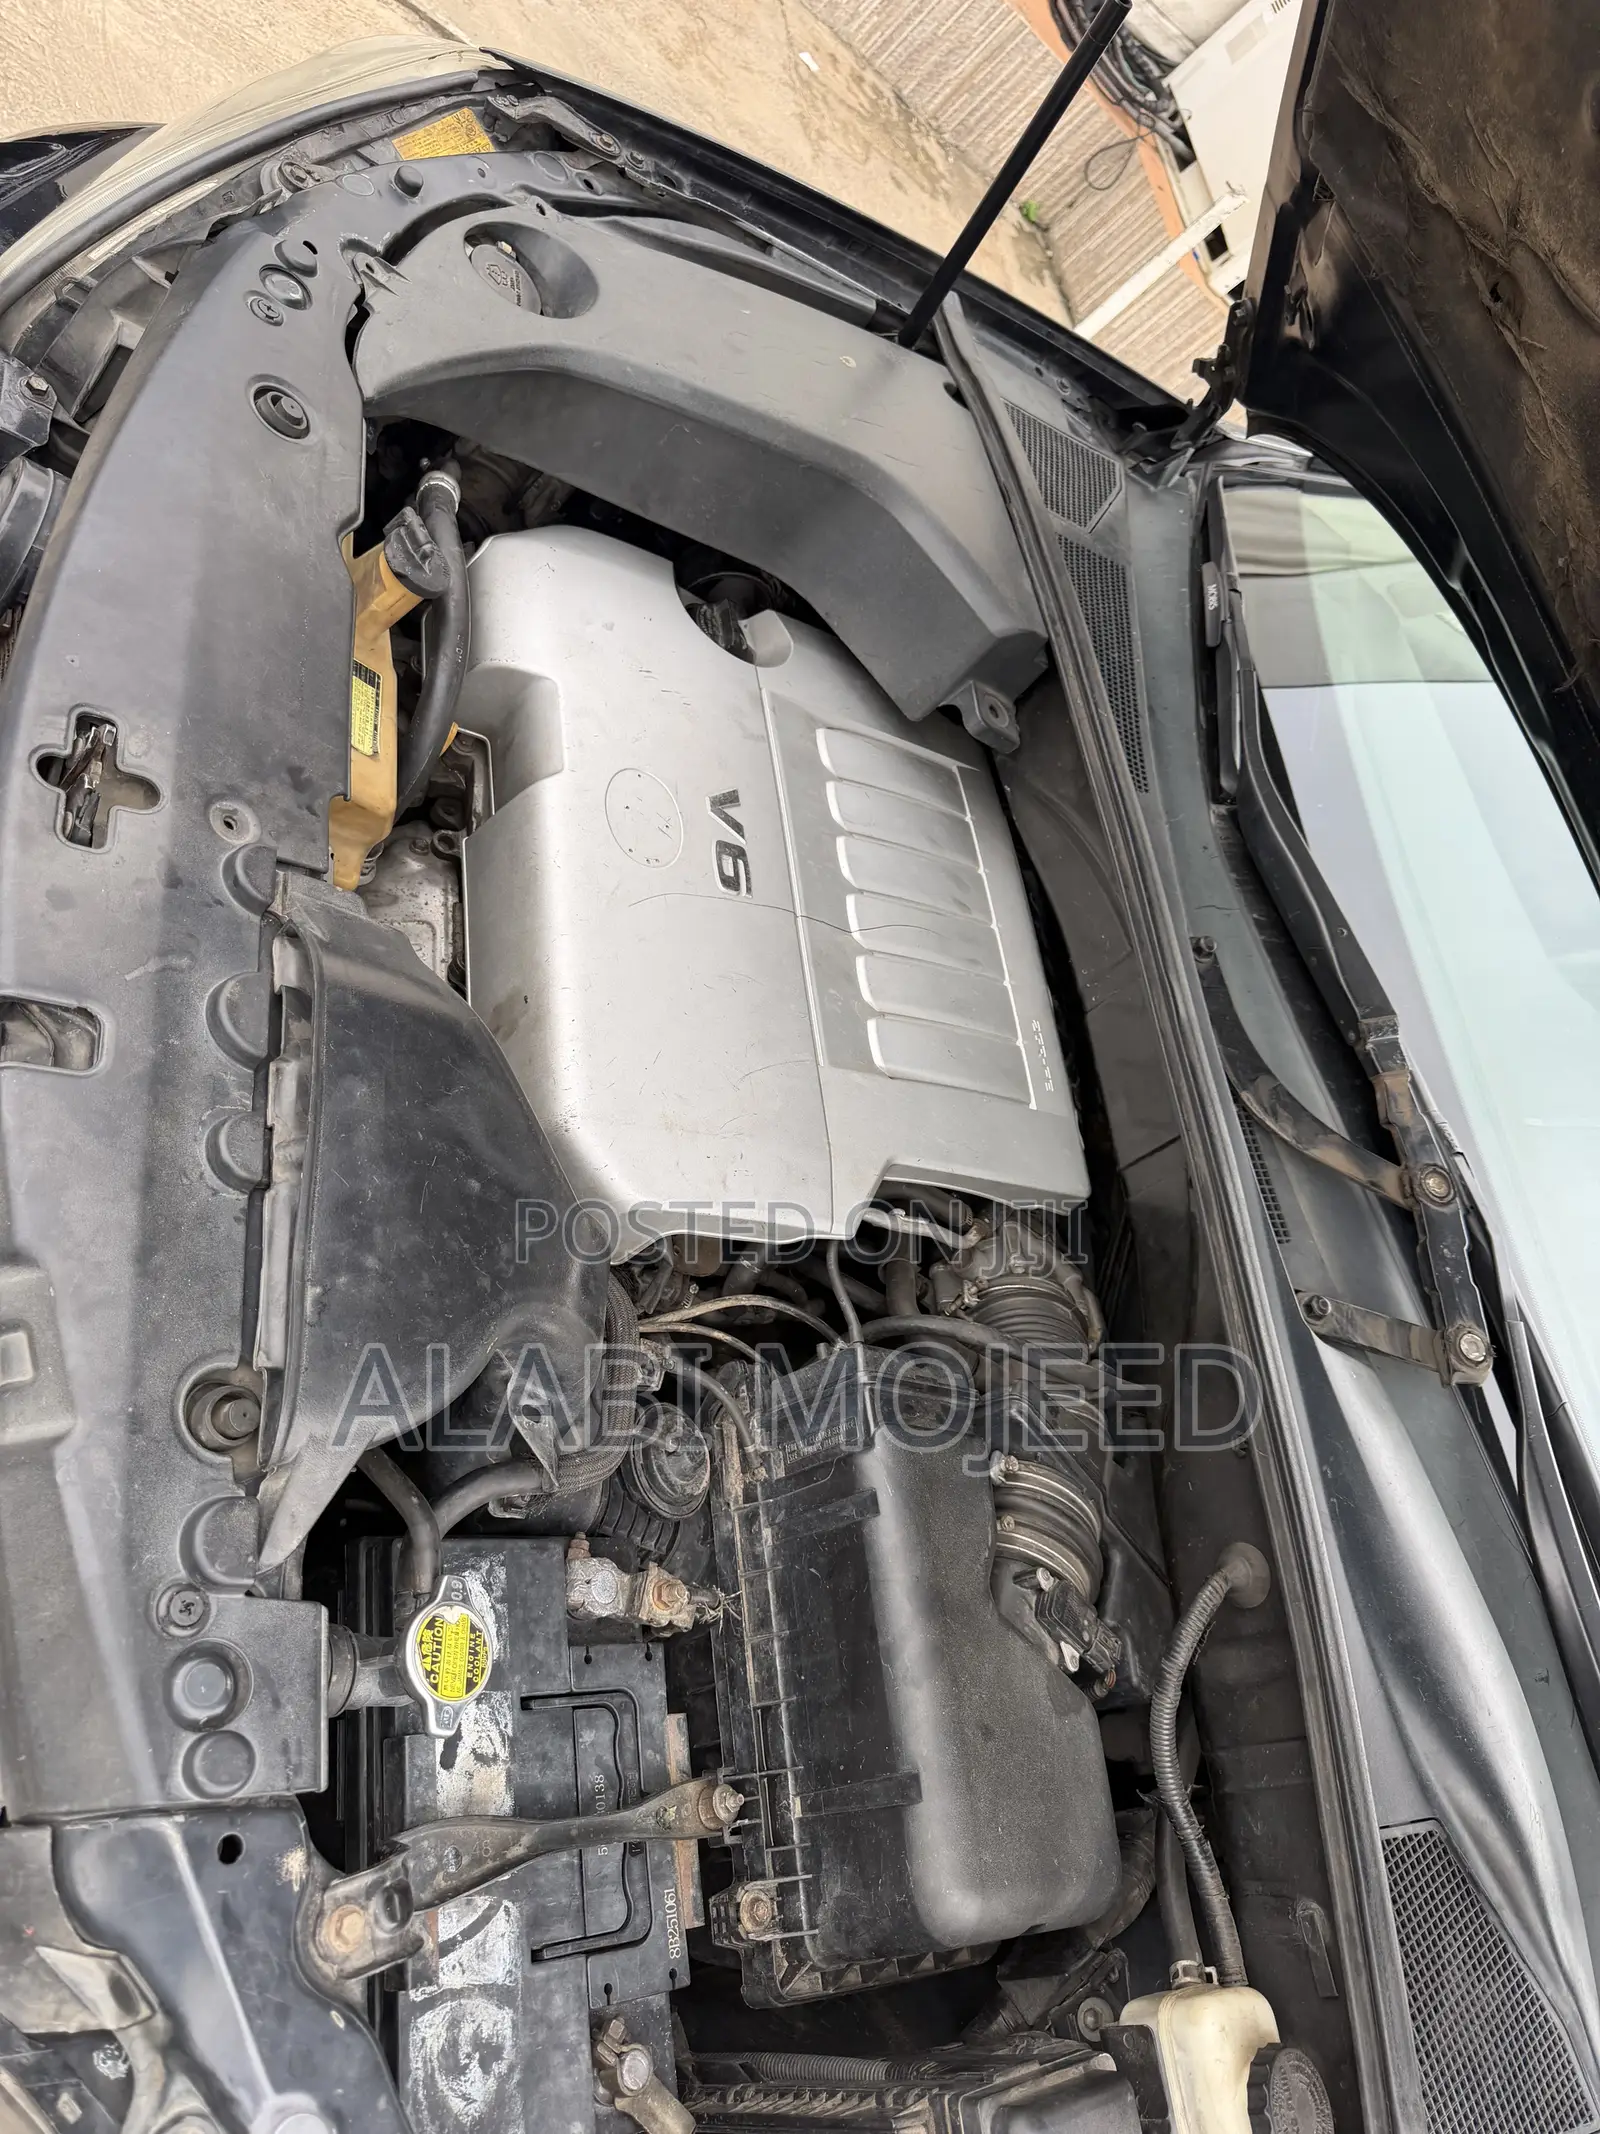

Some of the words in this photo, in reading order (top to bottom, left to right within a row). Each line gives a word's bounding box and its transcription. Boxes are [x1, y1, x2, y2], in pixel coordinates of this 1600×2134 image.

[704, 787, 753, 899] V6
[451, 1580, 465, 1601] 0.9
[429, 1617, 444, 1683] CAUTION
[467, 1633, 476, 1677] ENGINE
[473, 1631, 482, 1682] COOLANT
[663, 1886, 682, 1960] 8B251061
